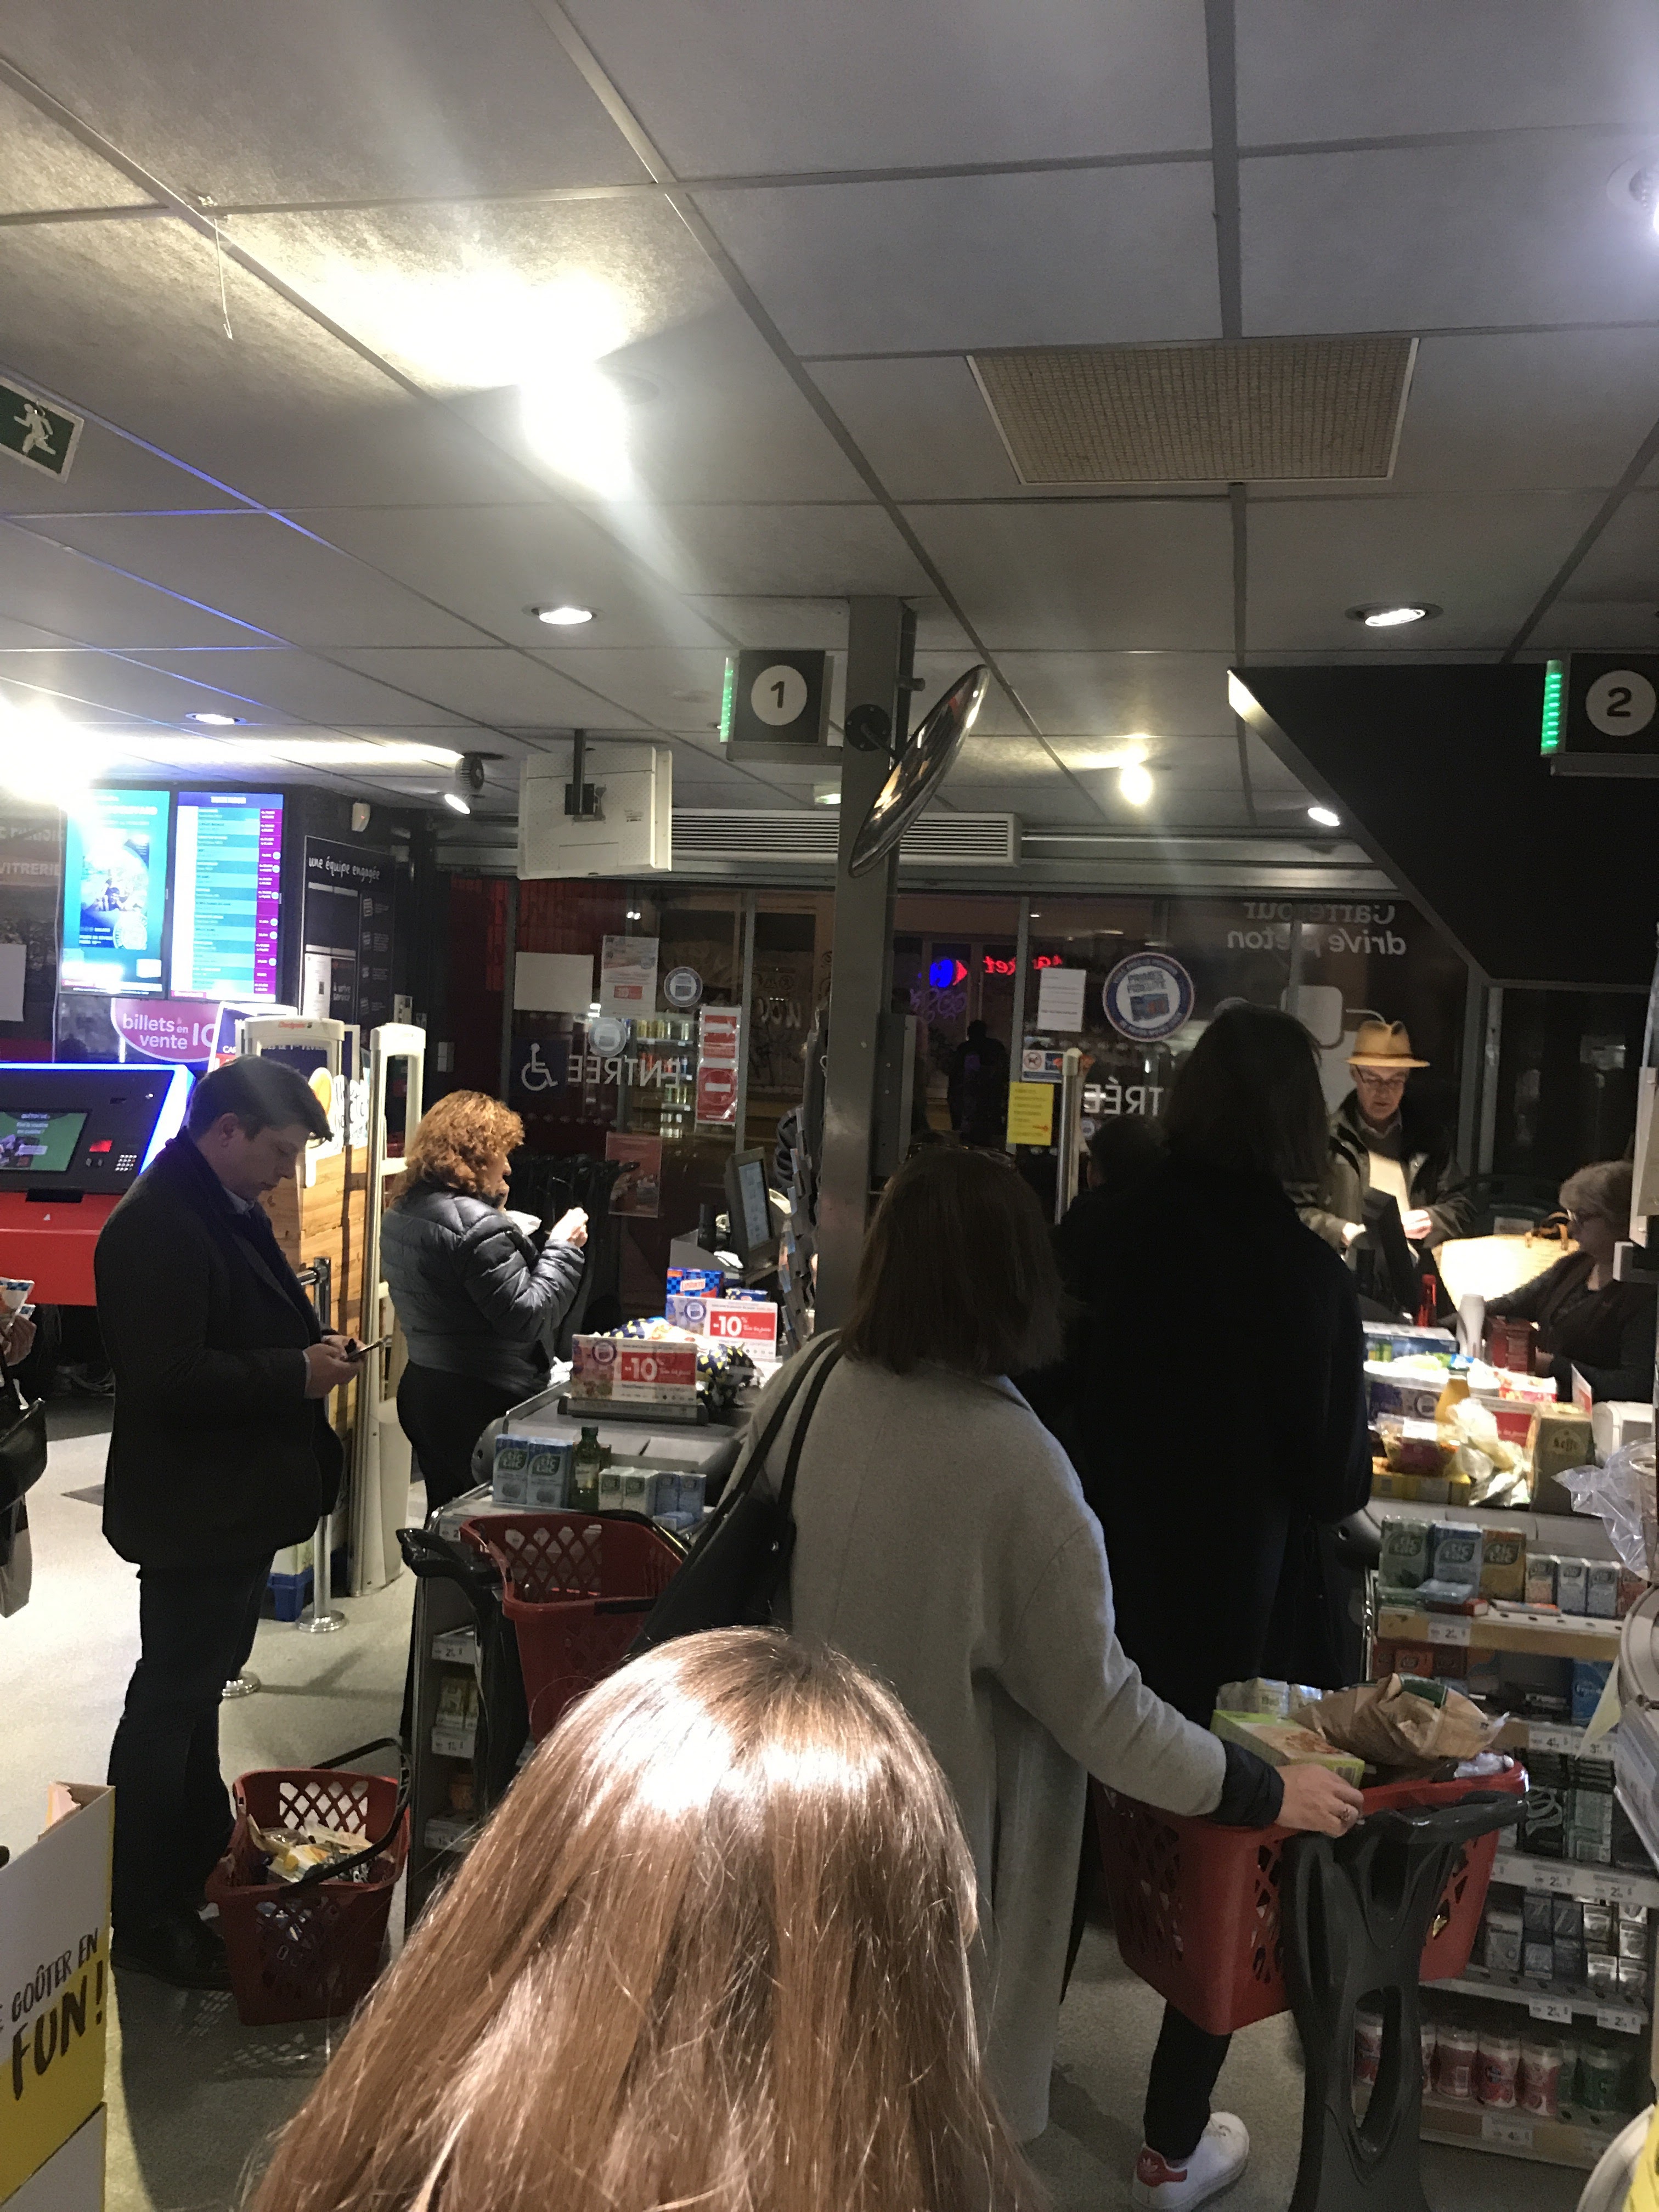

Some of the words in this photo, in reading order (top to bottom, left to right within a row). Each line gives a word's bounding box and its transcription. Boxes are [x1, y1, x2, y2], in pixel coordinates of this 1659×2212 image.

[770, 680, 785, 709] 1
[1606, 686, 1632, 717] 2
[308, 856, 324, 868] une
[325, 856, 351, 879] équipe
[352, 865, 381, 883] engagée
[122, 1013, 175, 1033] billets
[176, 1025, 189, 1034] en
[192, 1023, 216, 1048] IC
[139, 1034, 188, 1049] vente
[78, 1926, 98, 1969] EN
